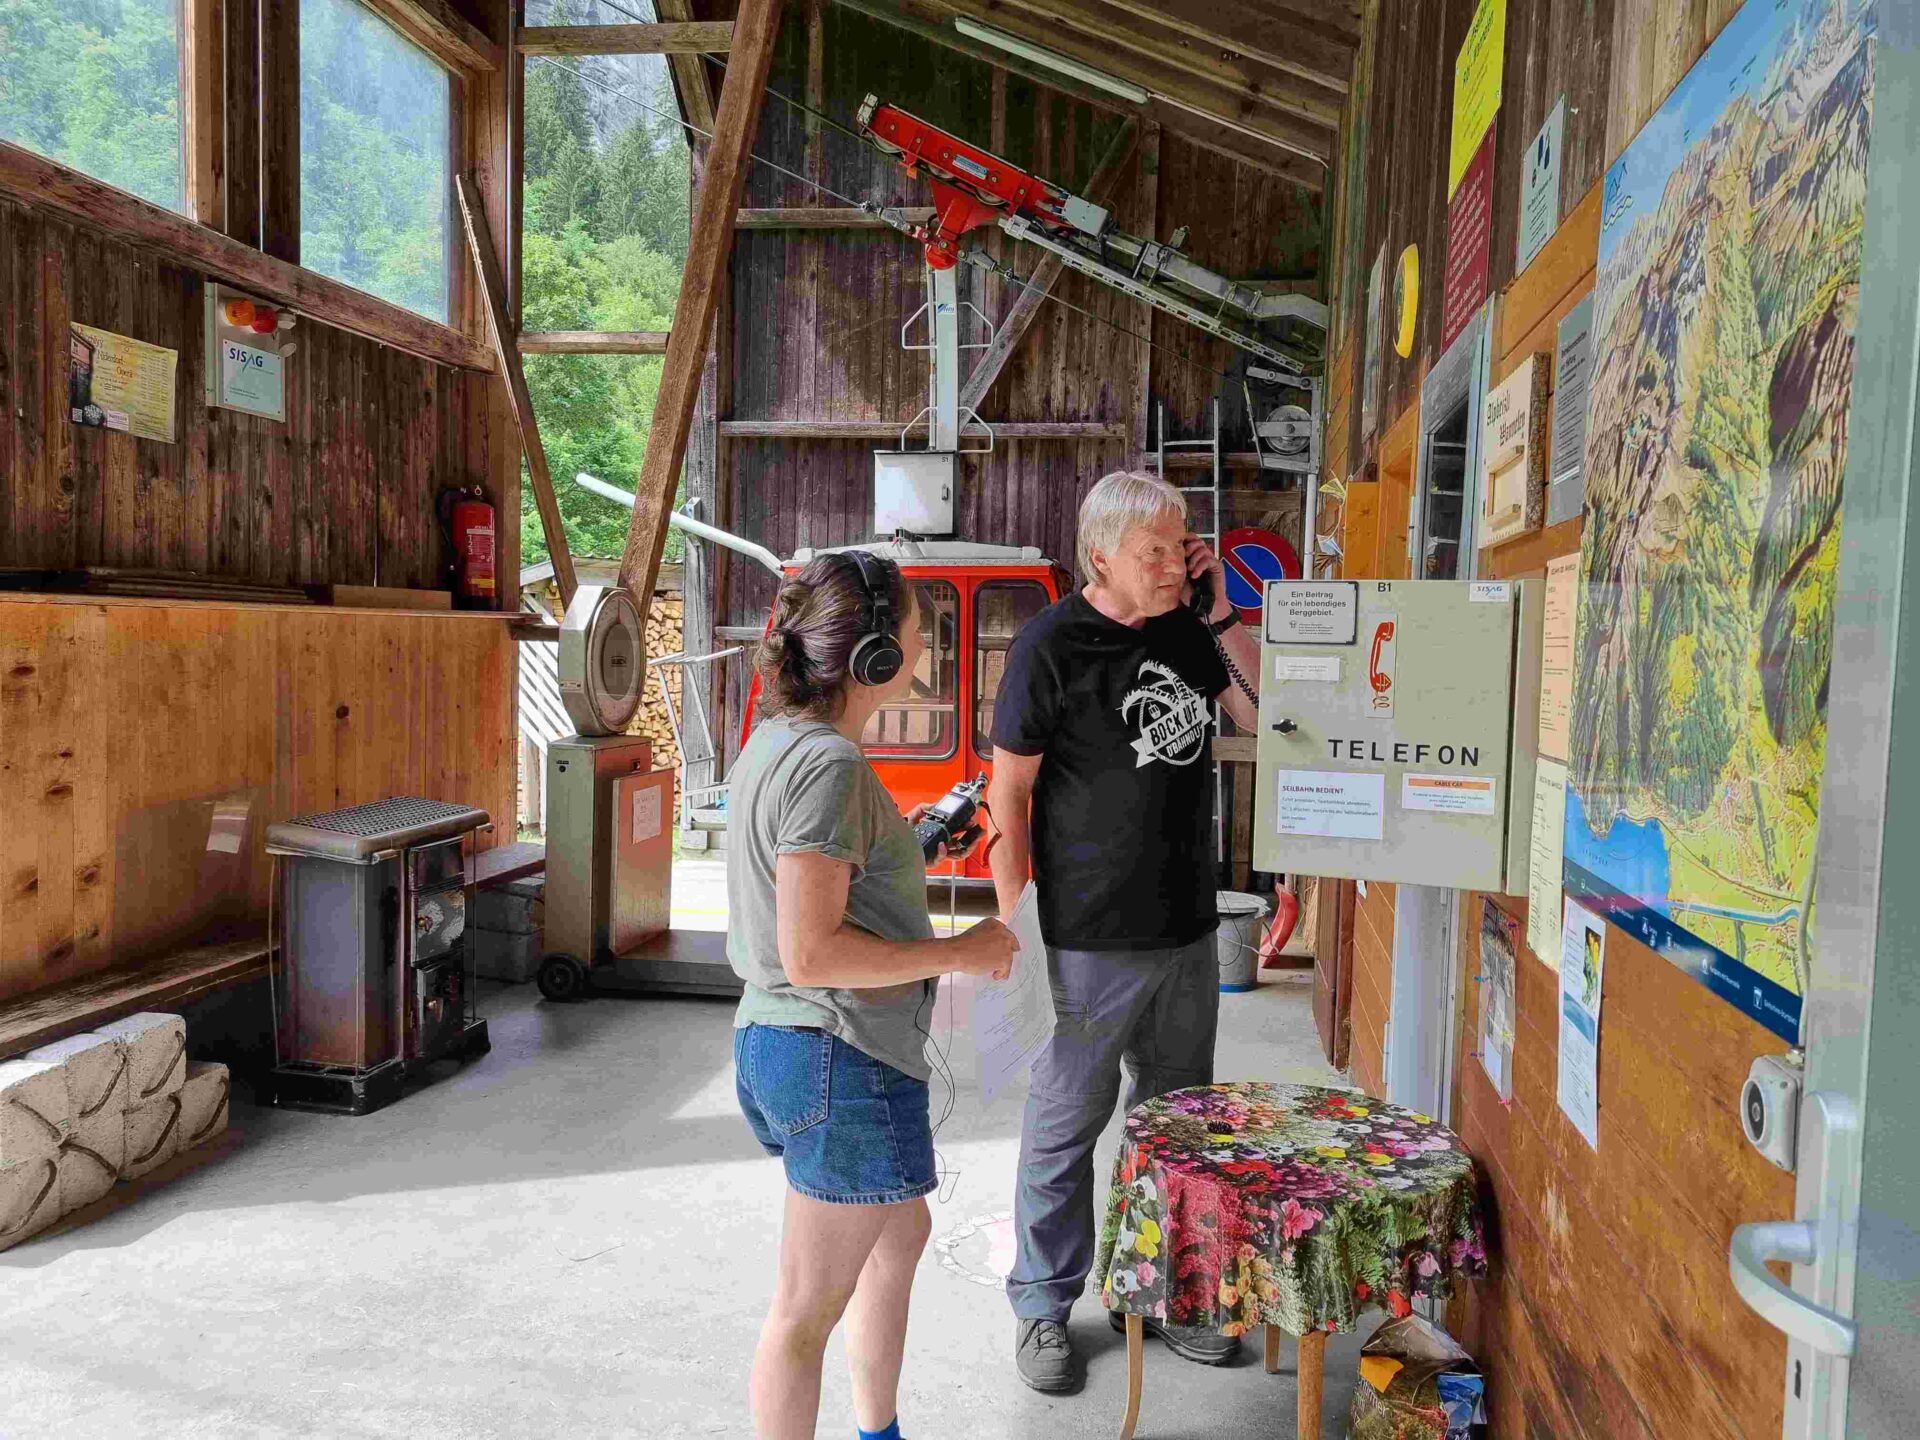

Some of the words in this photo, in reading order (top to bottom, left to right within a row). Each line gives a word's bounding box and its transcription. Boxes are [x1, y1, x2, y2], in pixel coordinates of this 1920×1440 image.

[229, 347, 263, 372] SISAG
[1377, 582, 1392, 592] B1
[1477, 585, 1503, 596] SISAG
[1305, 591, 1334, 600] Beitrag
[1304, 600, 1347, 608] lebendiges
[1289, 608, 1334, 618] Berggebiet.
[1149, 711, 1185, 747] BOCK
[1183, 699, 1198, 725] UF
[1328, 738, 1480, 767] TELEFON
[1282, 785, 1314, 793] SEILBAHN
